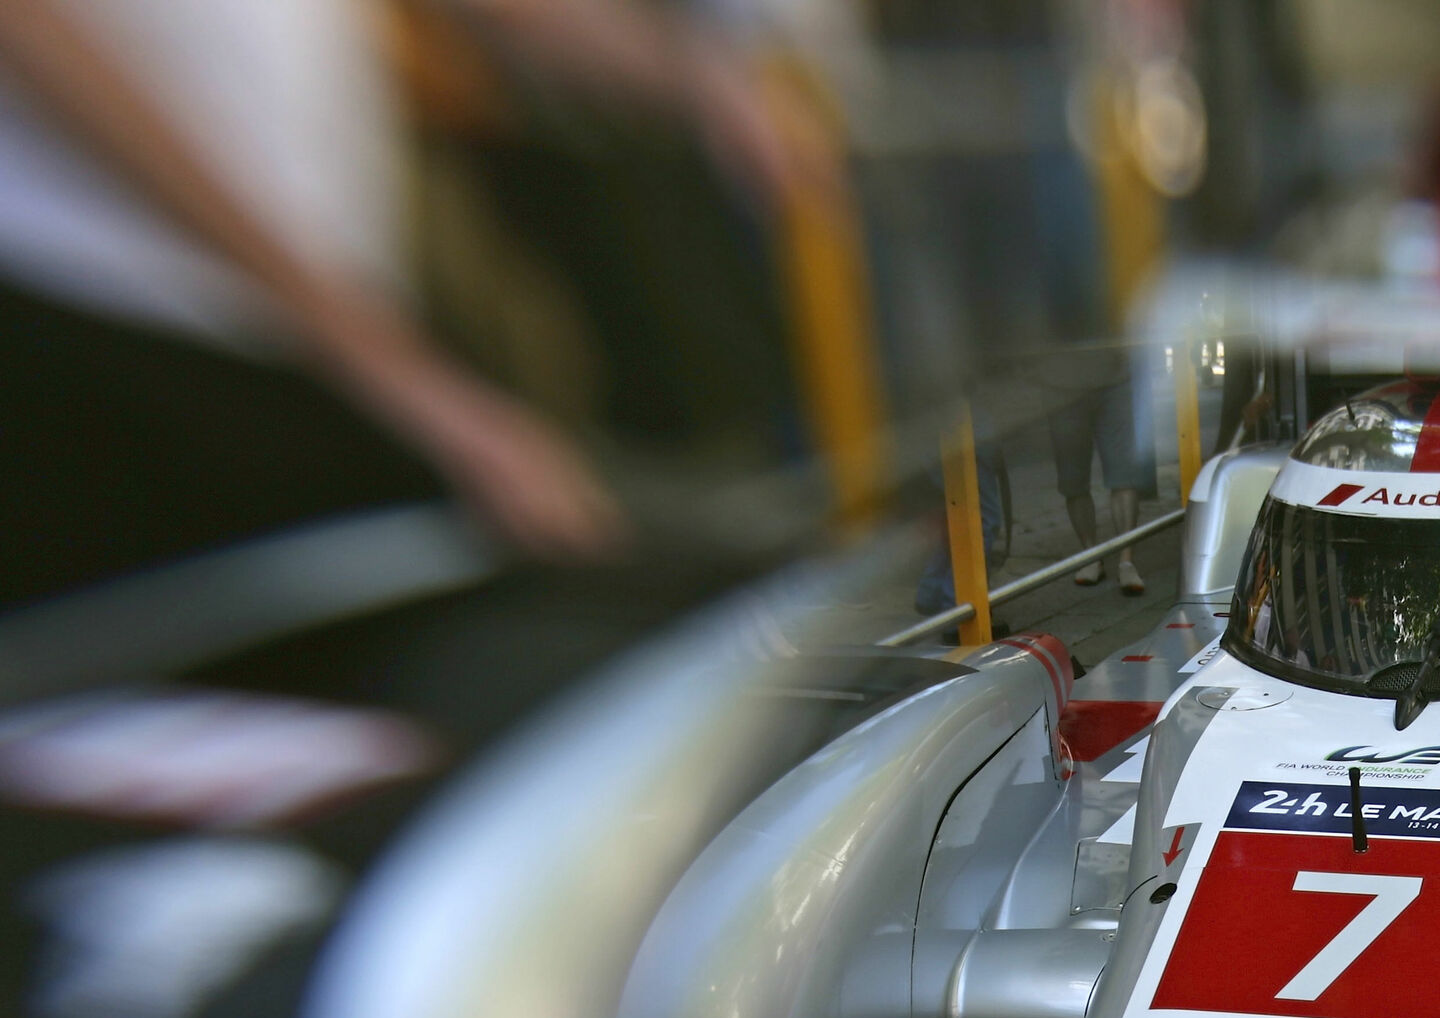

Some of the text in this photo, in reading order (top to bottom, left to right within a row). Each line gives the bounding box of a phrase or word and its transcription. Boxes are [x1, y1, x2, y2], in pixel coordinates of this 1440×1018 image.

[1275, 762, 1432, 774] FIA WORLD NDURANCE
[1333, 803, 1386, 819] LE
[1407, 821, 1440, 830] 13-14
[1274, 870, 1424, 1001] 7
